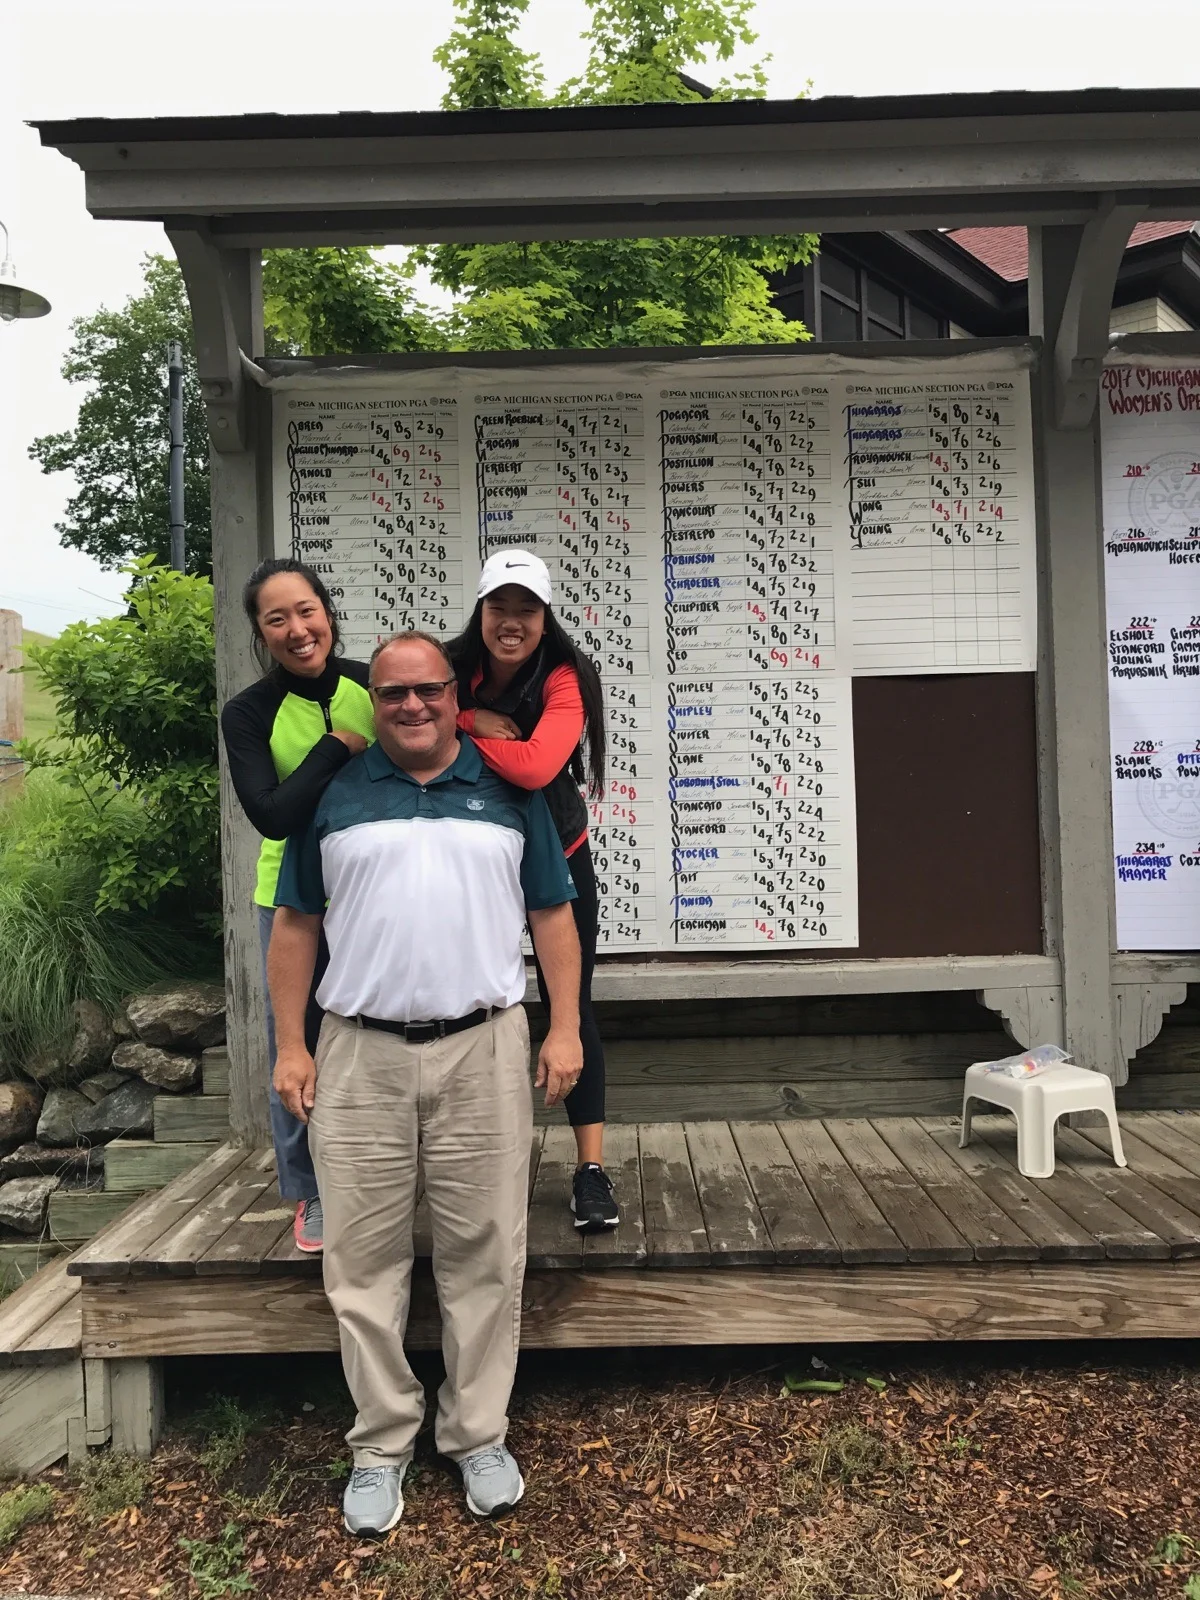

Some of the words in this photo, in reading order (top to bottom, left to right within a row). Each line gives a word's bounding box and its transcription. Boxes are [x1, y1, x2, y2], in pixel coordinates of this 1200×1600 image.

[875, 386, 923, 395] MICHIGAN
[926, 384, 965, 394] SECTION
[967, 384, 985, 392] PGA
[1102, 369, 1132, 390] 2017
[318, 402, 366, 411] MICHIGAN
[368, 400, 408, 410] SECTION
[410, 399, 428, 408] PGA
[504, 396, 552, 404] MICHIGAN
[553, 395, 593, 404] SECTION
[595, 394, 614, 402] PGA
[690, 391, 738, 399] MICHIGAN
[740, 390, 779, 399] SECTION
[781, 390, 800, 398] PGA
[1108, 389, 1172, 416] WOMEN'S
[371, 420, 389, 440] 154
[394, 420, 411, 439] 85
[416, 420, 444, 439] 239
[556, 439, 576, 459] 155
[580, 439, 596, 457] 77
[604, 438, 631, 457] 232
[743, 434, 762, 454] 144
[765, 434, 782, 453] 78
[790, 434, 813, 453] 222
[658, 457, 714, 482] POSTILLION
[930, 452, 949, 472] 143
[952, 452, 968, 470] 73
[978, 452, 1000, 470] 216
[290, 468, 332, 494] ARNOLD
[476, 462, 522, 488] HERBERT
[287, 491, 327, 516] BAKER
[372, 492, 392, 512] 142
[395, 492, 410, 511] 73
[424, 492, 444, 510] 215
[660, 482, 704, 506] POWERS
[478, 510, 514, 534] HOLLIS
[559, 510, 576, 530] 141
[582, 510, 598, 531] 74
[606, 511, 630, 532] 215
[849, 501, 882, 525] WONG
[978, 500, 1003, 520] 214
[289, 515, 330, 540] BELTON
[850, 524, 892, 550] YOUNG
[976, 523, 1004, 542] 222
[1128, 528, 1144, 538] 216
[288, 539, 332, 560] BROOKS
[662, 530, 714, 554] RESTREPO
[746, 530, 764, 550] 149
[768, 529, 784, 548] 72
[790, 530, 814, 548] 221
[374, 564, 393, 584] 150
[398, 563, 414, 584] 80
[420, 562, 446, 583] 230
[560, 558, 579, 578] 148
[582, 558, 599, 578] 76
[605, 558, 631, 578] 224
[662, 554, 714, 580] ROBINSON
[665, 578, 720, 602] SCHROEDER
[376, 612, 394, 631] 151
[399, 610, 414, 630] 75
[422, 611, 446, 630] 226
[748, 602, 766, 622] 143
[770, 600, 787, 620] 74
[794, 600, 819, 621] 217
[1130, 616, 1150, 628] 222
[666, 626, 698, 650] SCOTT
[1110, 630, 1154, 642] ELSHOLZ
[1110, 642, 1165, 655] STANFORD
[1112, 654, 1152, 664] YOUNG
[667, 650, 688, 674] SEO
[749, 649, 768, 669] 145
[770, 648, 788, 668] 69
[795, 648, 820, 668] 214
[610, 686, 636, 706] 224
[668, 682, 713, 707] SHIPLEY
[668, 706, 712, 730] SHIPLEY
[1134, 740, 1154, 752] 228
[669, 754, 704, 778] SLANE
[751, 753, 770, 773] 150
[774, 753, 791, 772] 78
[798, 753, 823, 772] 228
[1115, 754, 1152, 768] SLANE
[1115, 766, 1162, 780] BROOKS
[612, 781, 636, 801] 208
[590, 804, 603, 824] 71
[671, 801, 722, 825] STANCATO
[590, 828, 606, 848] 74
[612, 828, 636, 847] 226
[672, 824, 726, 848] STANFORD
[753, 824, 772, 845] 147
[776, 822, 792, 844] 75
[798, 822, 826, 842] 222
[1136, 842, 1156, 854] 234
[672, 848, 719, 872] STOCKER
[670, 872, 698, 896] TAIT
[1118, 867, 1168, 882] KRAMER
[614, 898, 639, 918] 221
[670, 895, 713, 918] TANIDA
[755, 896, 774, 916] 145
[778, 894, 794, 915] 74
[800, 894, 824, 915] 219
[617, 923, 641, 942] 227
[670, 919, 726, 944] TEACHMAN
